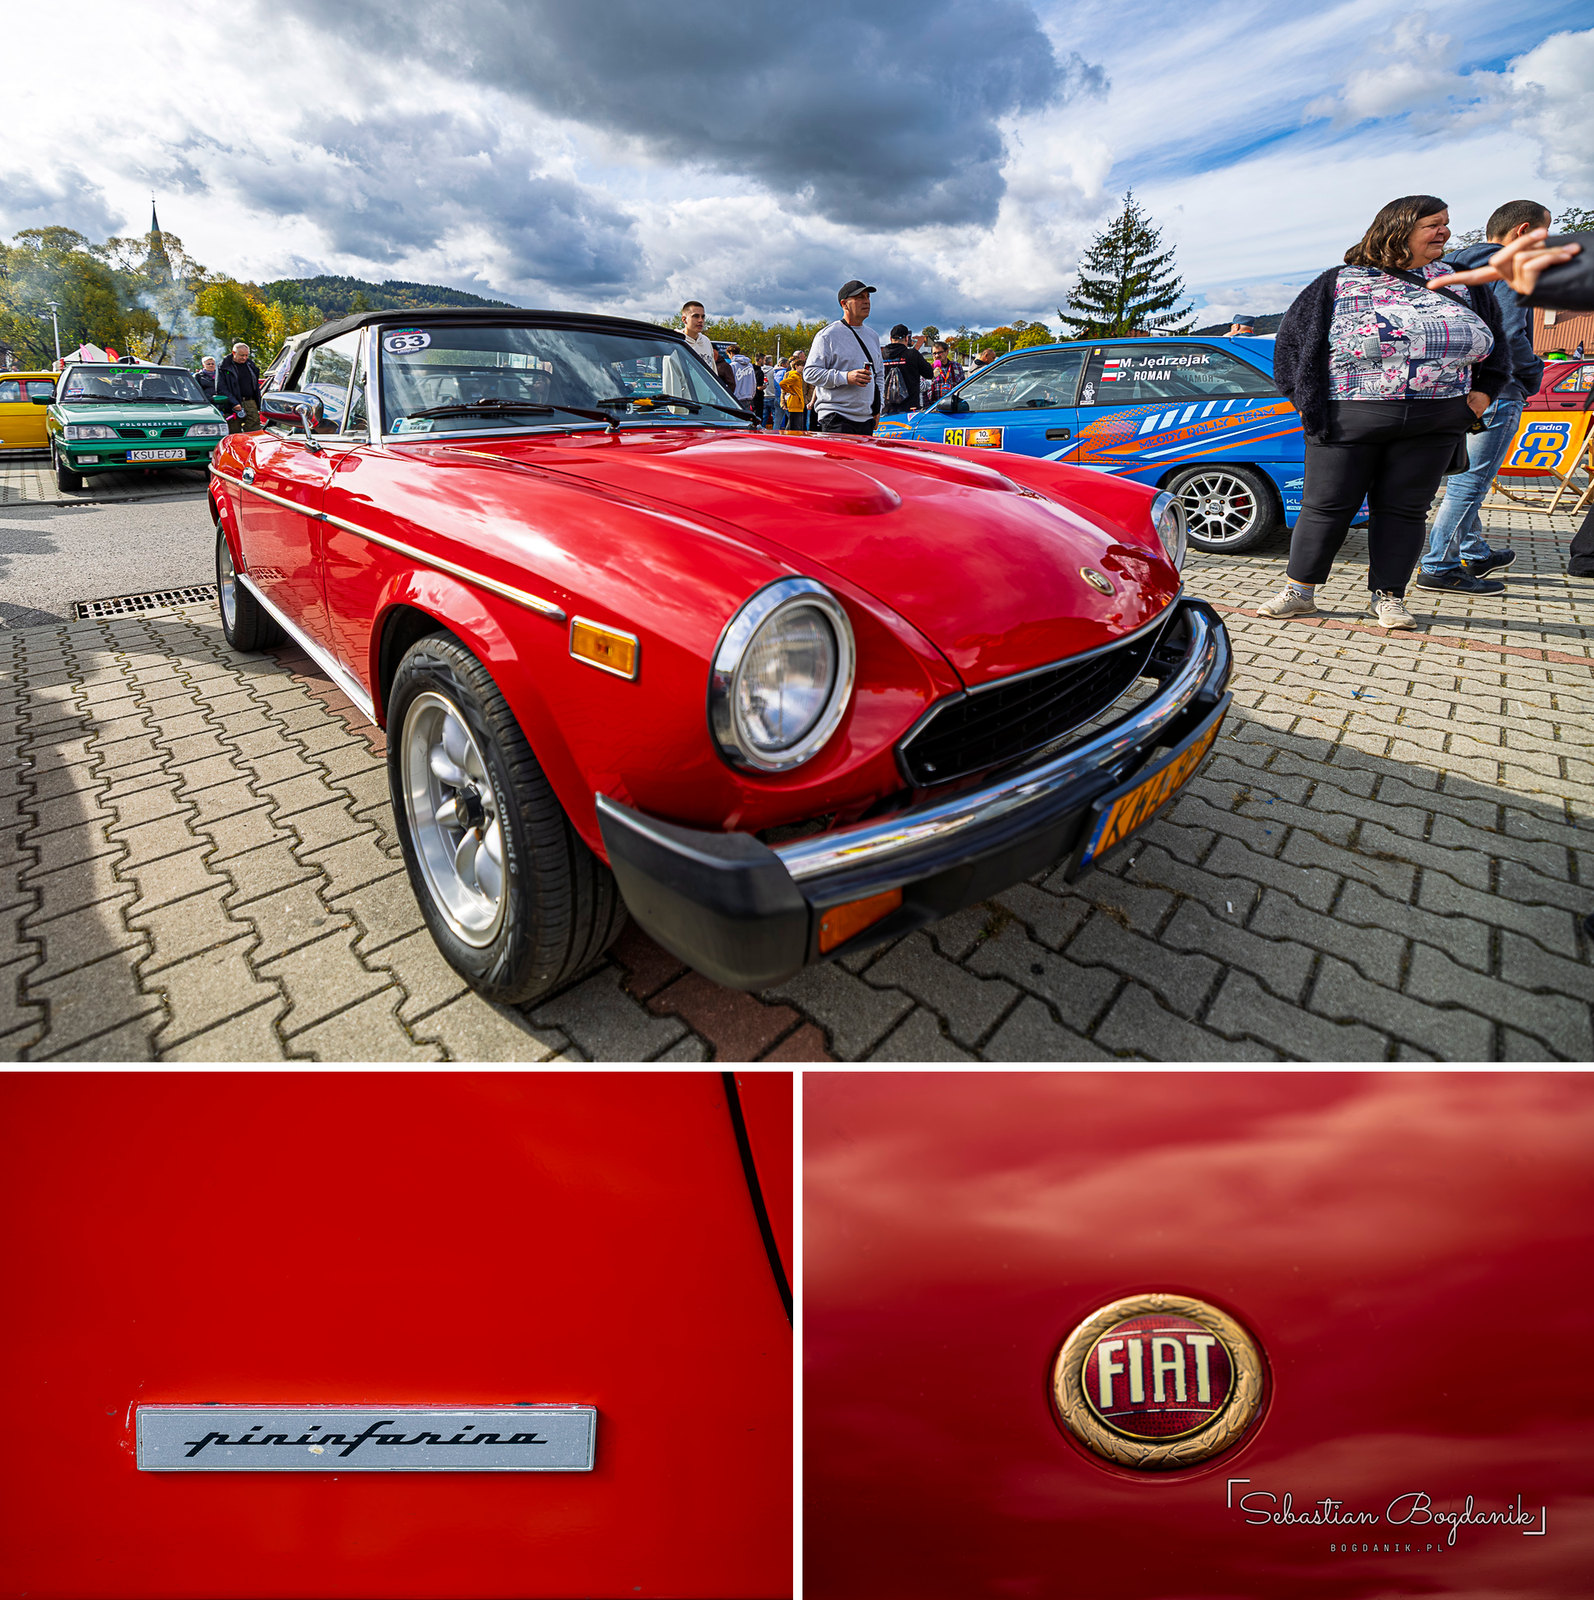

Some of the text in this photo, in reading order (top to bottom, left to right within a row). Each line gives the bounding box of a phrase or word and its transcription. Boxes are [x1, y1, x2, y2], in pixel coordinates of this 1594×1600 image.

[390, 335, 425, 349] 63
[1119, 354, 1210, 368] M. Jędrzejak
[1133, 370, 1172, 381] ROMAN
[1186, 417, 1230, 438] RALLY
[1234, 406, 1276, 424] TEAM
[1534, 423, 1562, 431] radio
[945, 429, 963, 446] 36
[133, 450, 184, 460] KSU EC73
[509, 862, 520, 875] 6
[1097, 1334, 1216, 1409] FIAT
[184, 1420, 548, 1457] pininfarina
